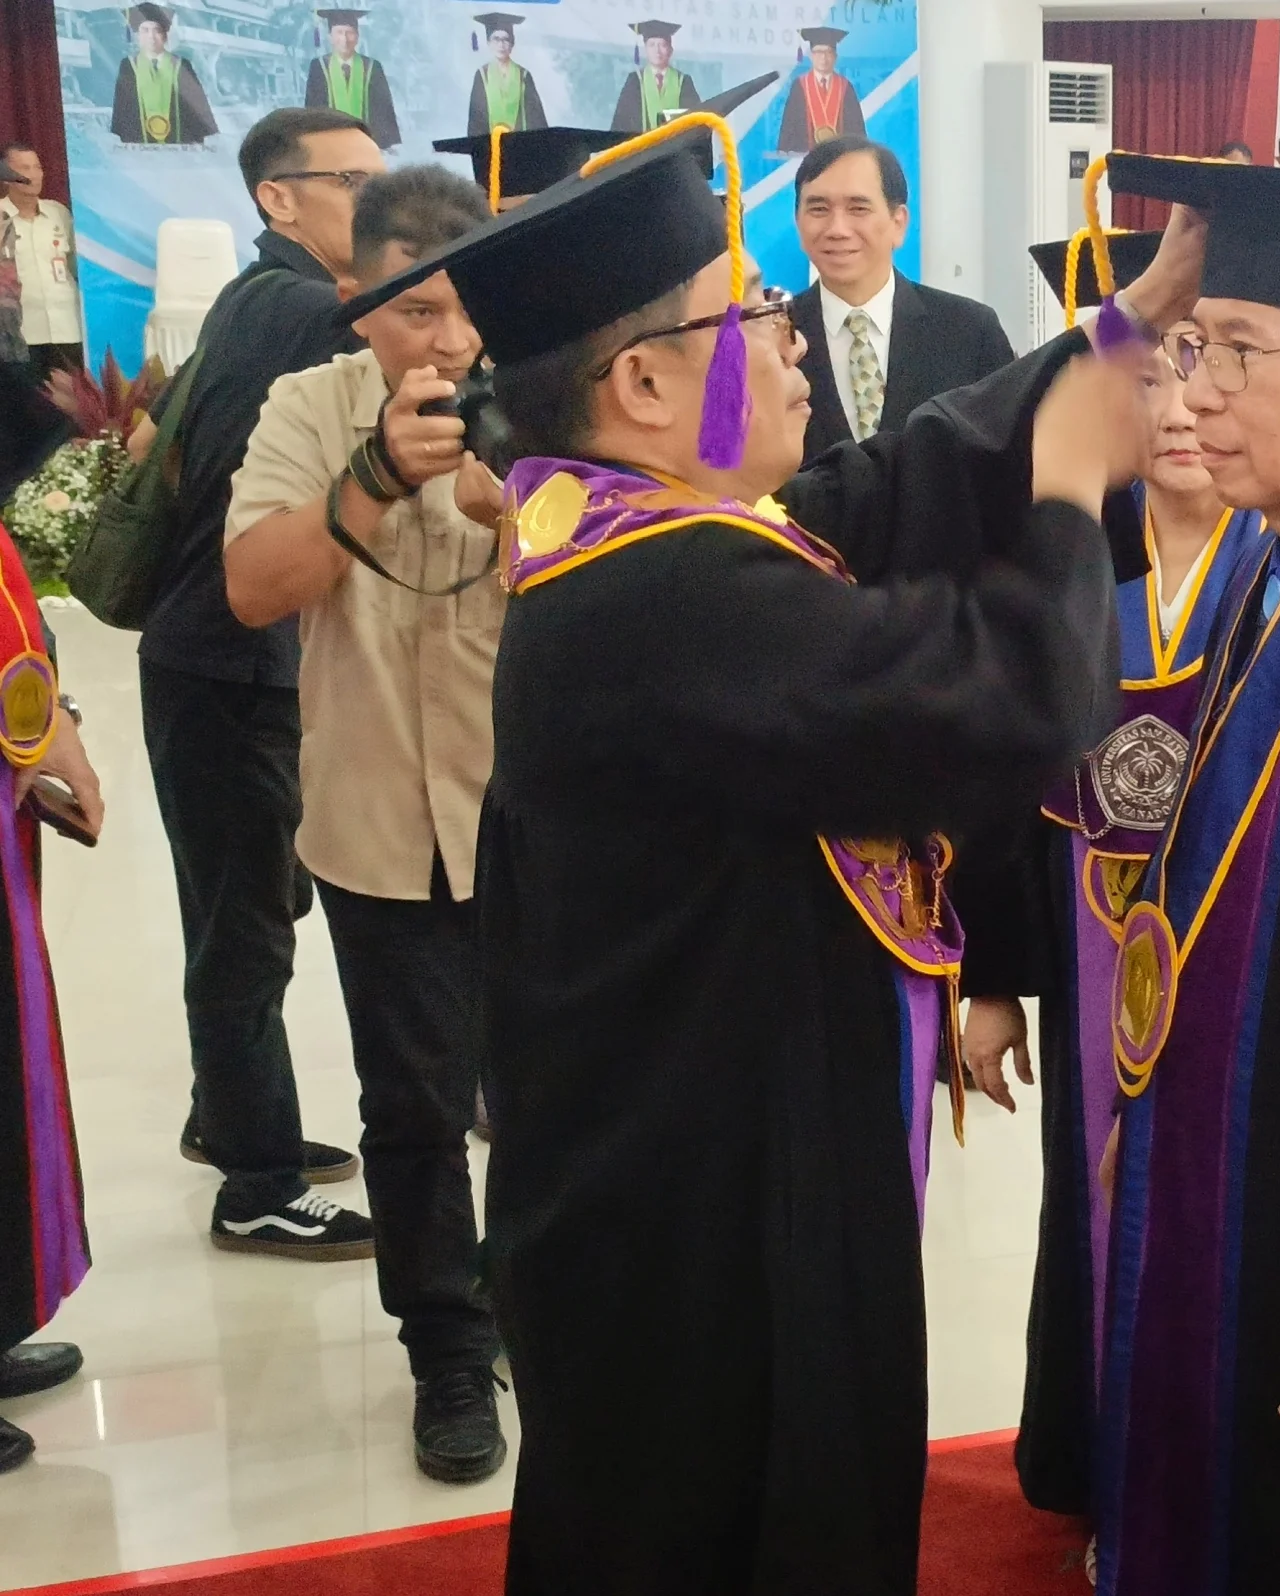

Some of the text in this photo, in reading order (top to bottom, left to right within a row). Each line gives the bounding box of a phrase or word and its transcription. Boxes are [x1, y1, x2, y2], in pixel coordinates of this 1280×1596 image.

[731, 2, 778, 21] SAM
[691, 23, 793, 46] MANADO
[1101, 728, 1139, 785] UNIVERSITAS
